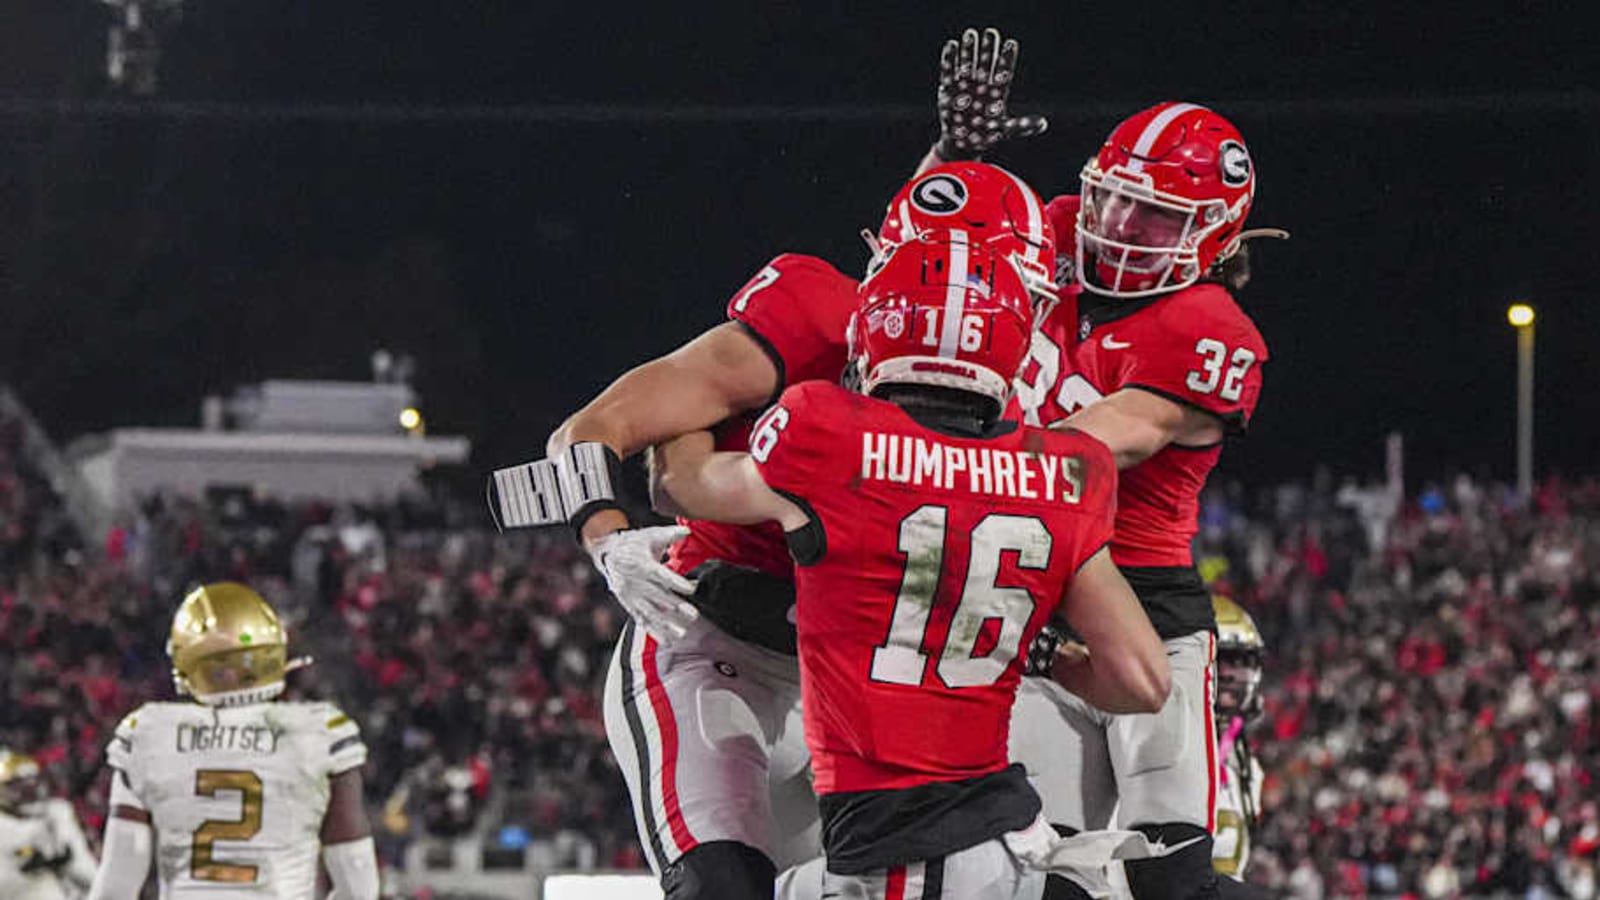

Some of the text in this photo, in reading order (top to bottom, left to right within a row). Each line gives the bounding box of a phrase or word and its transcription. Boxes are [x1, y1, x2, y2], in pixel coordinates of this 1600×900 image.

[1221, 141, 1250, 185] G
[911, 174, 967, 214] G
[734, 265, 781, 313] 7
[922, 308, 984, 352] 16
[1185, 337, 1256, 401] 32
[862, 432, 1083, 504] HUMPHREYS
[869, 505, 1054, 688] 16
[190, 768, 264, 882] 2
